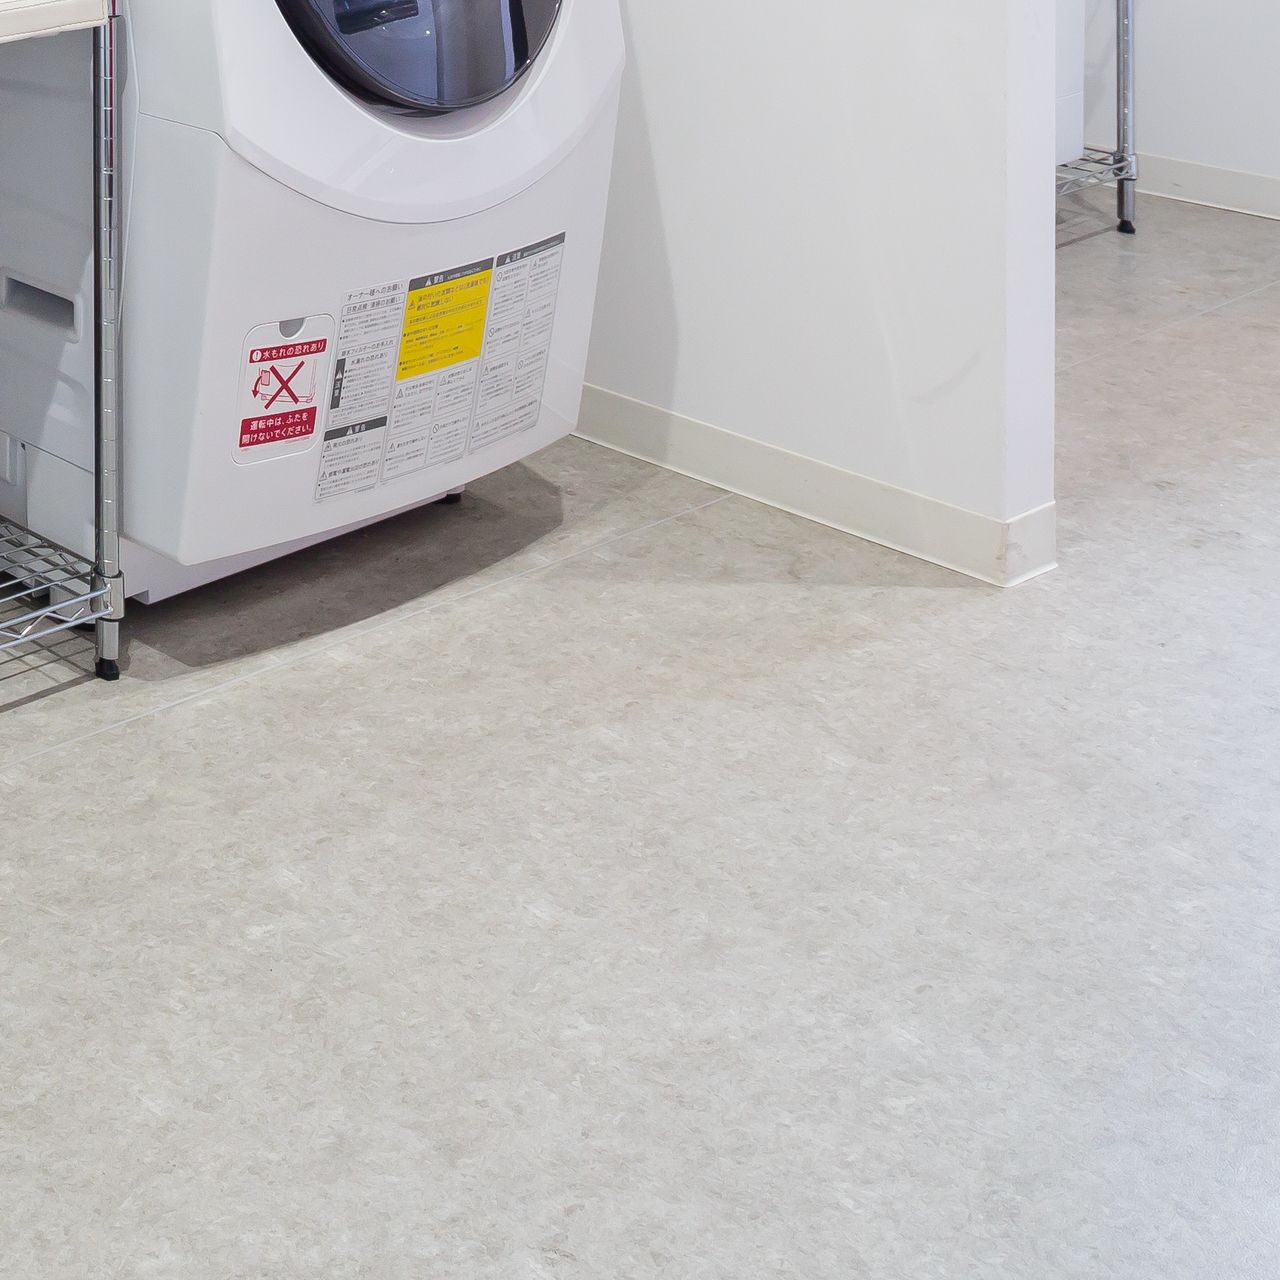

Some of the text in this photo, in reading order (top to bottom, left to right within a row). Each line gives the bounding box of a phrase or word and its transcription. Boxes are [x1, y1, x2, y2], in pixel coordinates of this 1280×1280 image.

[263, 342, 324, 359] 水もれの恐れあり
[250, 413, 308, 430] 運転中は、ふたを
[242, 425, 312, 444] 開けないでください。
